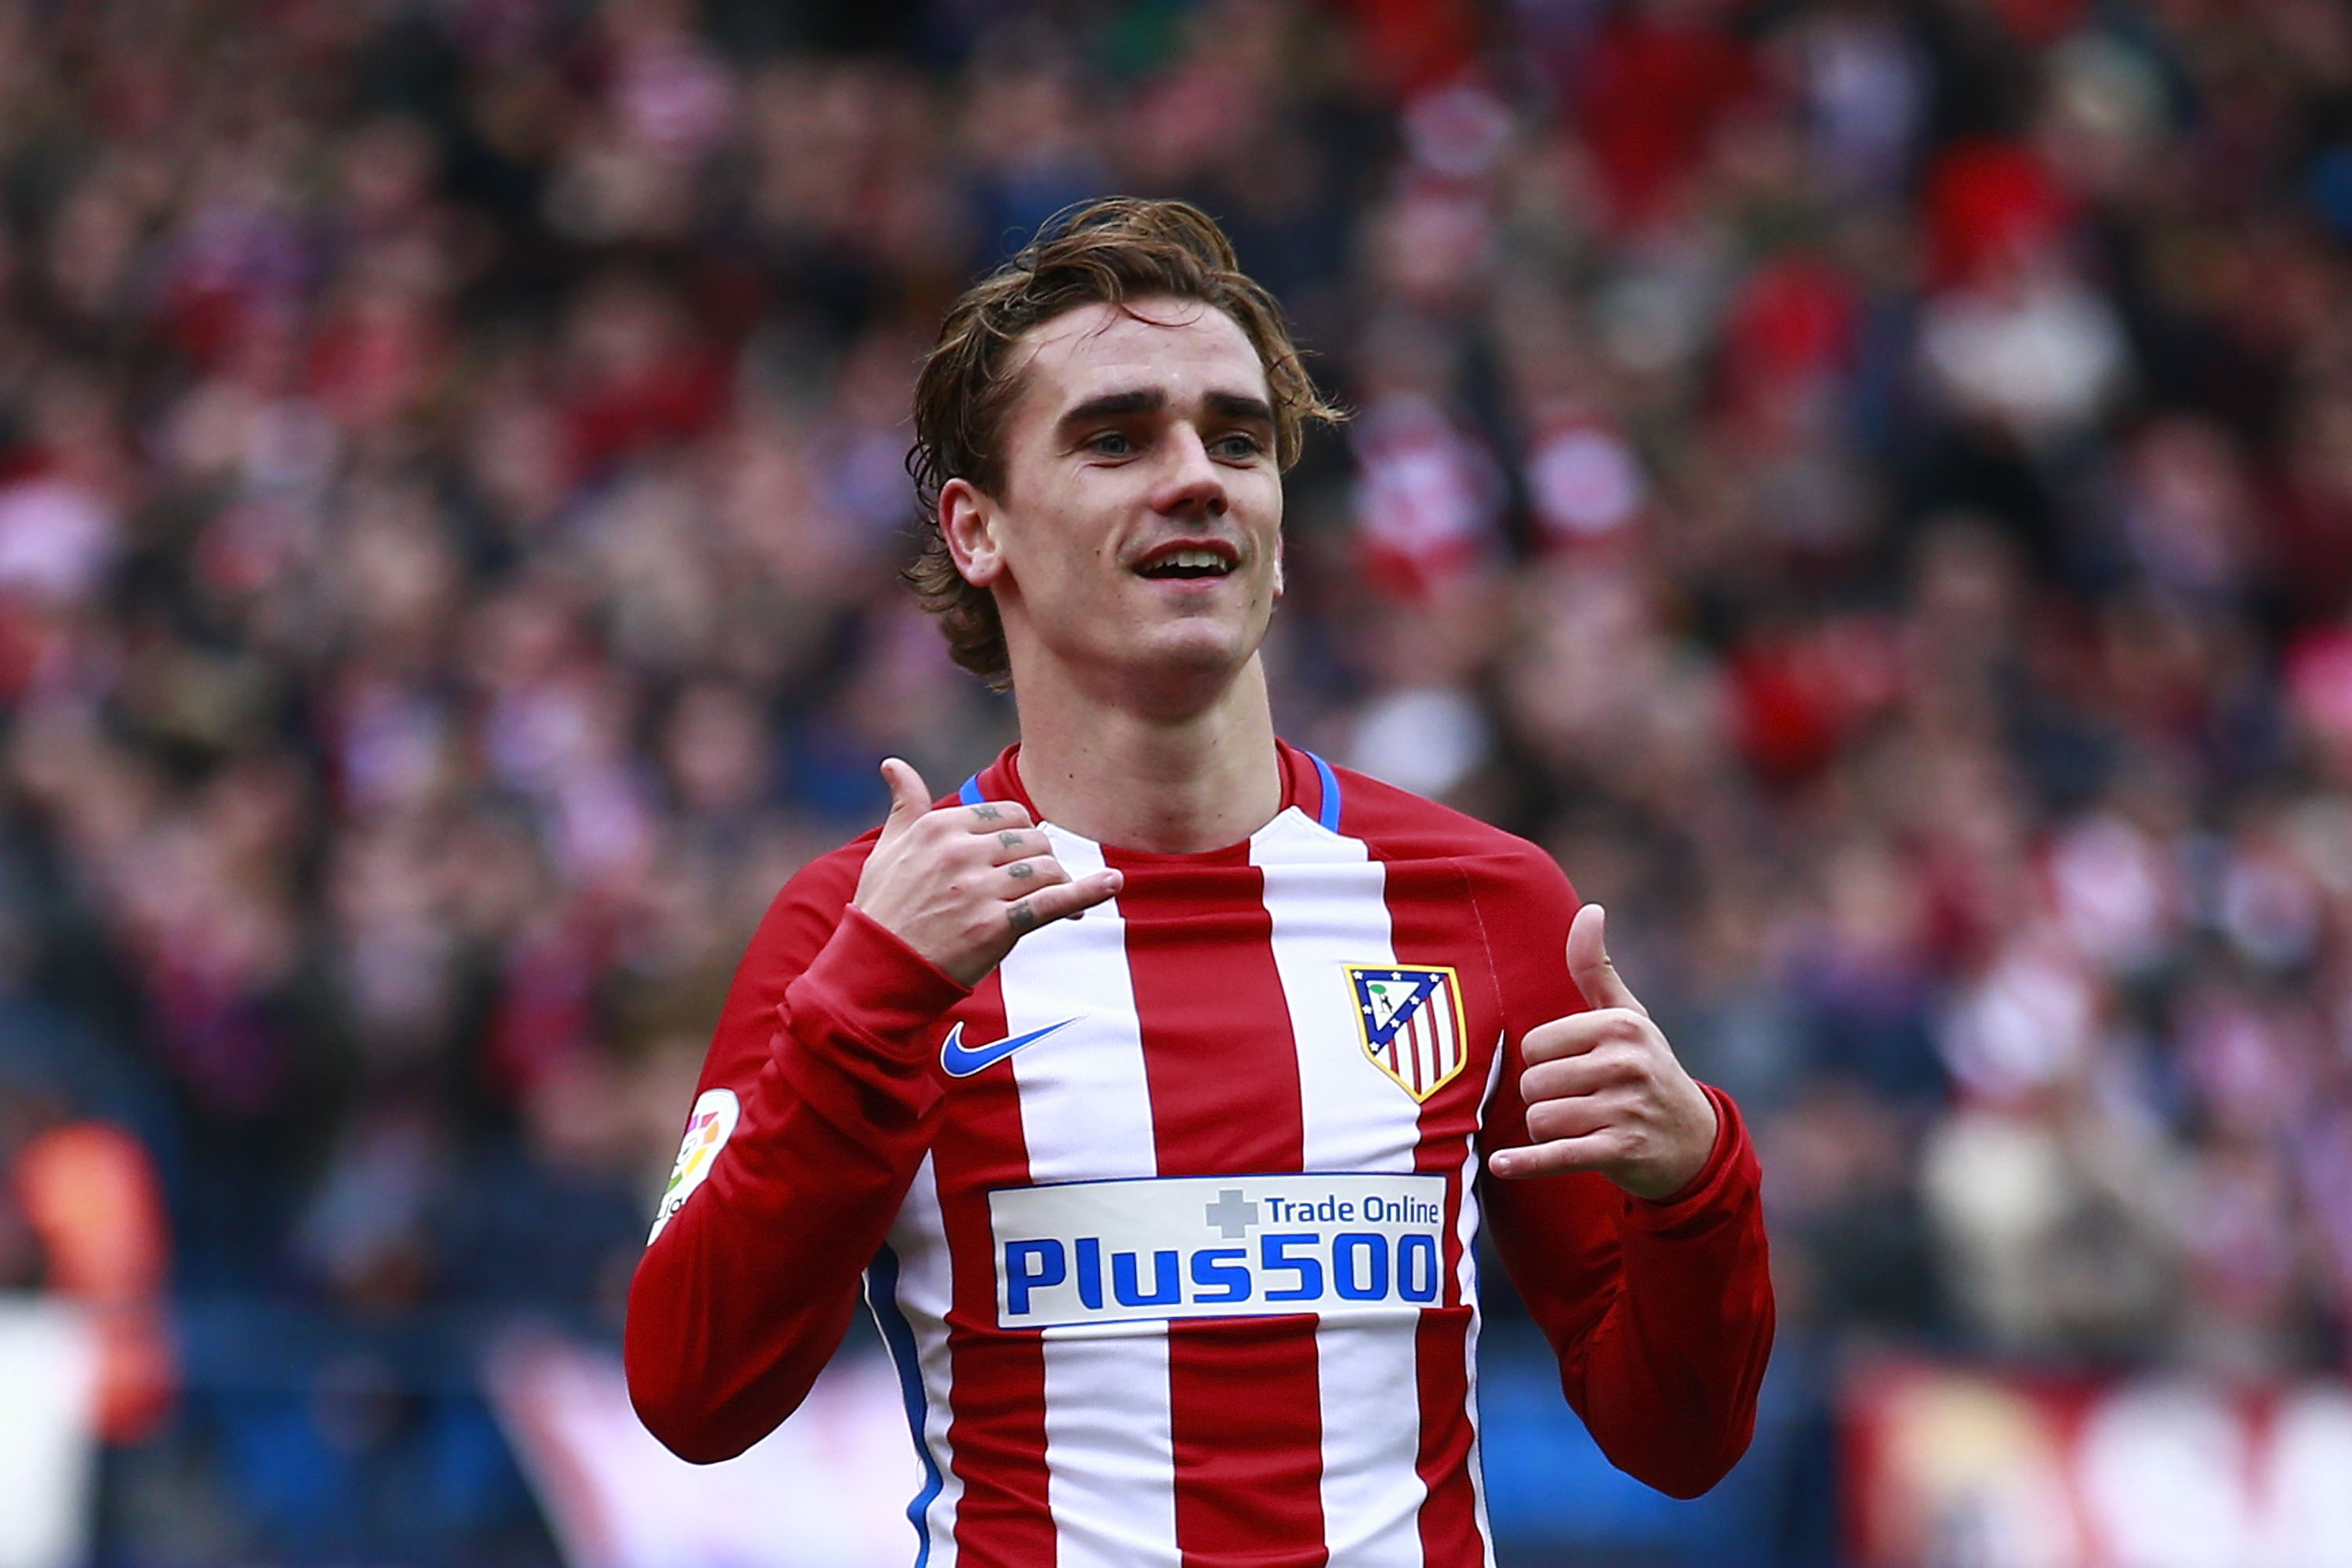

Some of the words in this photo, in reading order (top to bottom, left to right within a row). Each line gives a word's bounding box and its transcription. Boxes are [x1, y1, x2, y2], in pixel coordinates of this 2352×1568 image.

[1265, 1195, 1355, 1224] Trade
[1363, 1196, 1439, 1224] Online
[1005, 1233, 1438, 1315] Plus500
